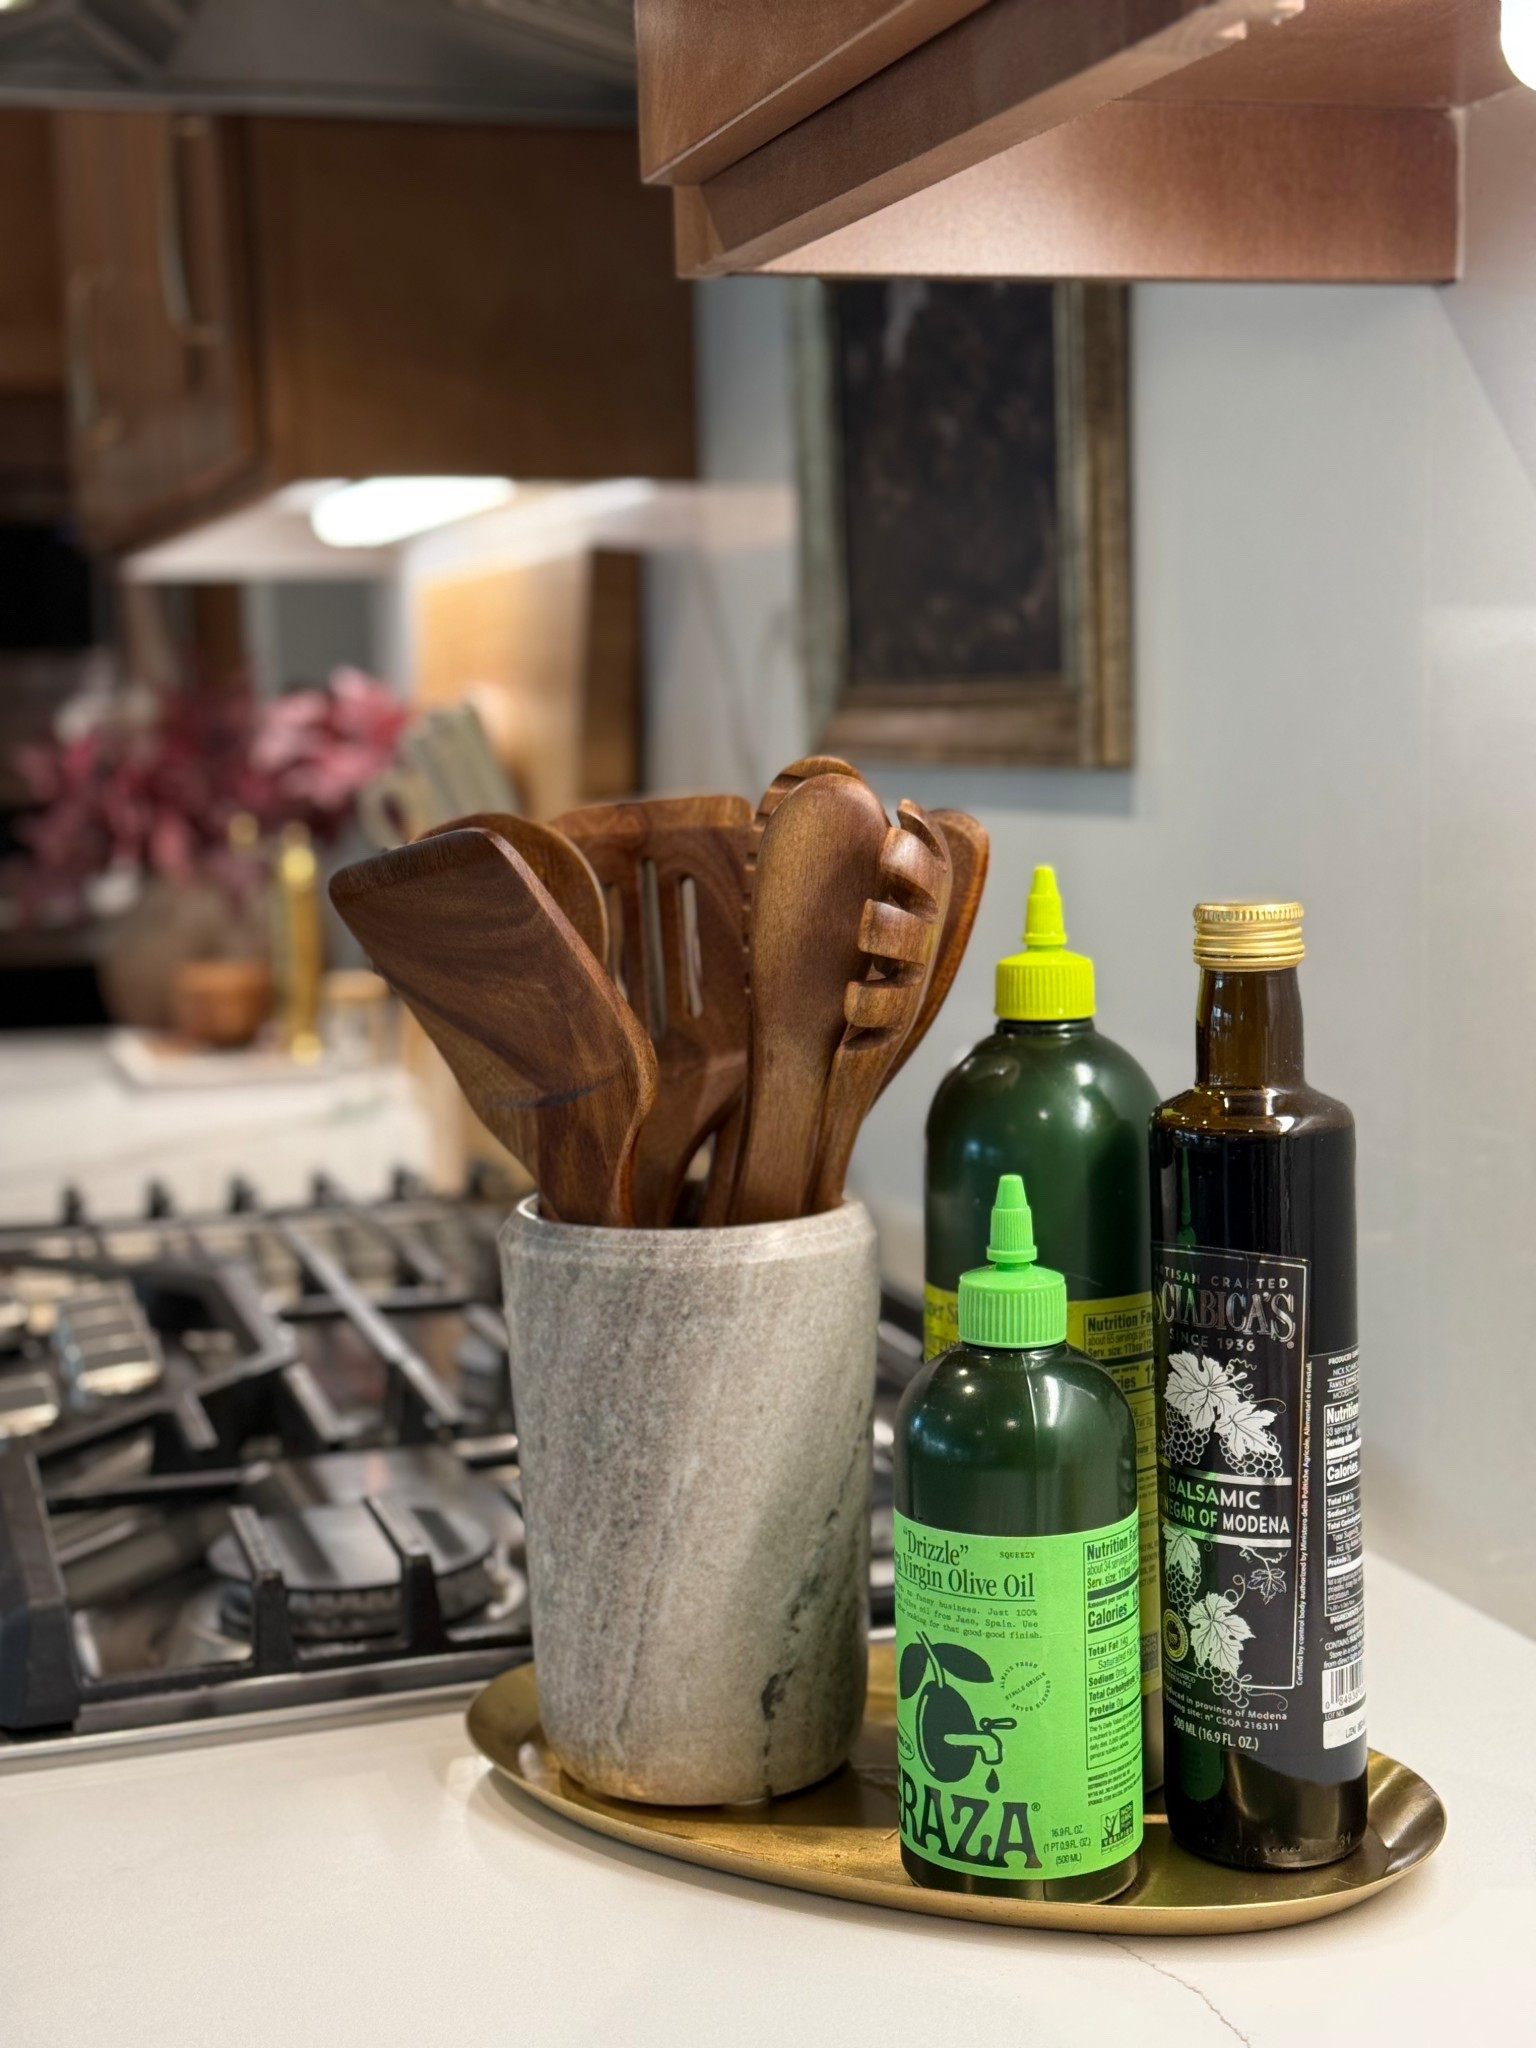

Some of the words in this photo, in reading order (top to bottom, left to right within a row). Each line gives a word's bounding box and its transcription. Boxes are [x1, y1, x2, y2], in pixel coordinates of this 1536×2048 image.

[1160, 1265, 1200, 1285] TISAN
[1087, 1313, 1138, 1333] Nutrition
[1169, 1327, 1209, 1349] SINCE
[1217, 1337, 1256, 1352] 1936
[1303, 1399, 1311, 1435] Alimentari
[1327, 1461, 1358, 1481] Calories
[1168, 1474, 1261, 1510] BALSAMIC
[1302, 1468, 1310, 1498] Politiche
[1163, 1494, 1196, 1525] NEGAR
[1199, 1508, 1219, 1528] OF
[1222, 1512, 1290, 1534] MODENA
[1301, 1499, 1309, 1516] delle
[1300, 1517, 1308, 1550] Ministero
[999, 1551, 1036, 1560] SQUEEZY
[1086, 1536, 1128, 1562] Nutrition
[1300, 1551, 1308, 1560] by
[903, 1552, 944, 1591] Virgin
[948, 1568, 998, 1597] Olive
[1003, 1572, 1036, 1598] Oil
[1299, 1561, 1307, 1599] authorized
[934, 1610, 952, 1621] from
[987, 1607, 1009, 1617] Just
[1016, 1608, 1038, 1617] 100%
[1087, 1603, 1127, 1628] Calories
[1298, 1600, 1307, 1618] body
[1297, 1619, 1305, 1644] control
[1088, 1643, 1107, 1657] Total
[1108, 1640, 1119, 1652] Fat
[1297, 1644, 1305, 1654] by
[1088, 1672, 1115, 1687] Sodium
[1296, 1655, 1304, 1685] Certified
[1088, 1688, 1106, 1702] Total
[1089, 1702, 1116, 1717] Protein
[1194, 1700, 1233, 1716] province
[1234, 1709, 1246, 1718] of
[1247, 1710, 1288, 1721] Modena
[1324, 1712, 1335, 1721] LOT
[1216, 1716, 1242, 1728] CSQA
[1244, 1720, 1280, 1731] 216311
[1185, 1720, 1197, 1738] ML
[1198, 1725, 1221, 1744] (16.9
[1222, 1732, 1237, 1748] FL.
[1238, 1735, 1259, 1752] OZ.)
[898, 1764, 1043, 1869] RAZA
[1051, 1827, 1064, 1838] 16.9
[1043, 1844, 1050, 1854] (1
[1050, 1842, 1059, 1852] PT
[1056, 1854, 1070, 1867] (500
[1070, 1853, 1083, 1864] ML)
